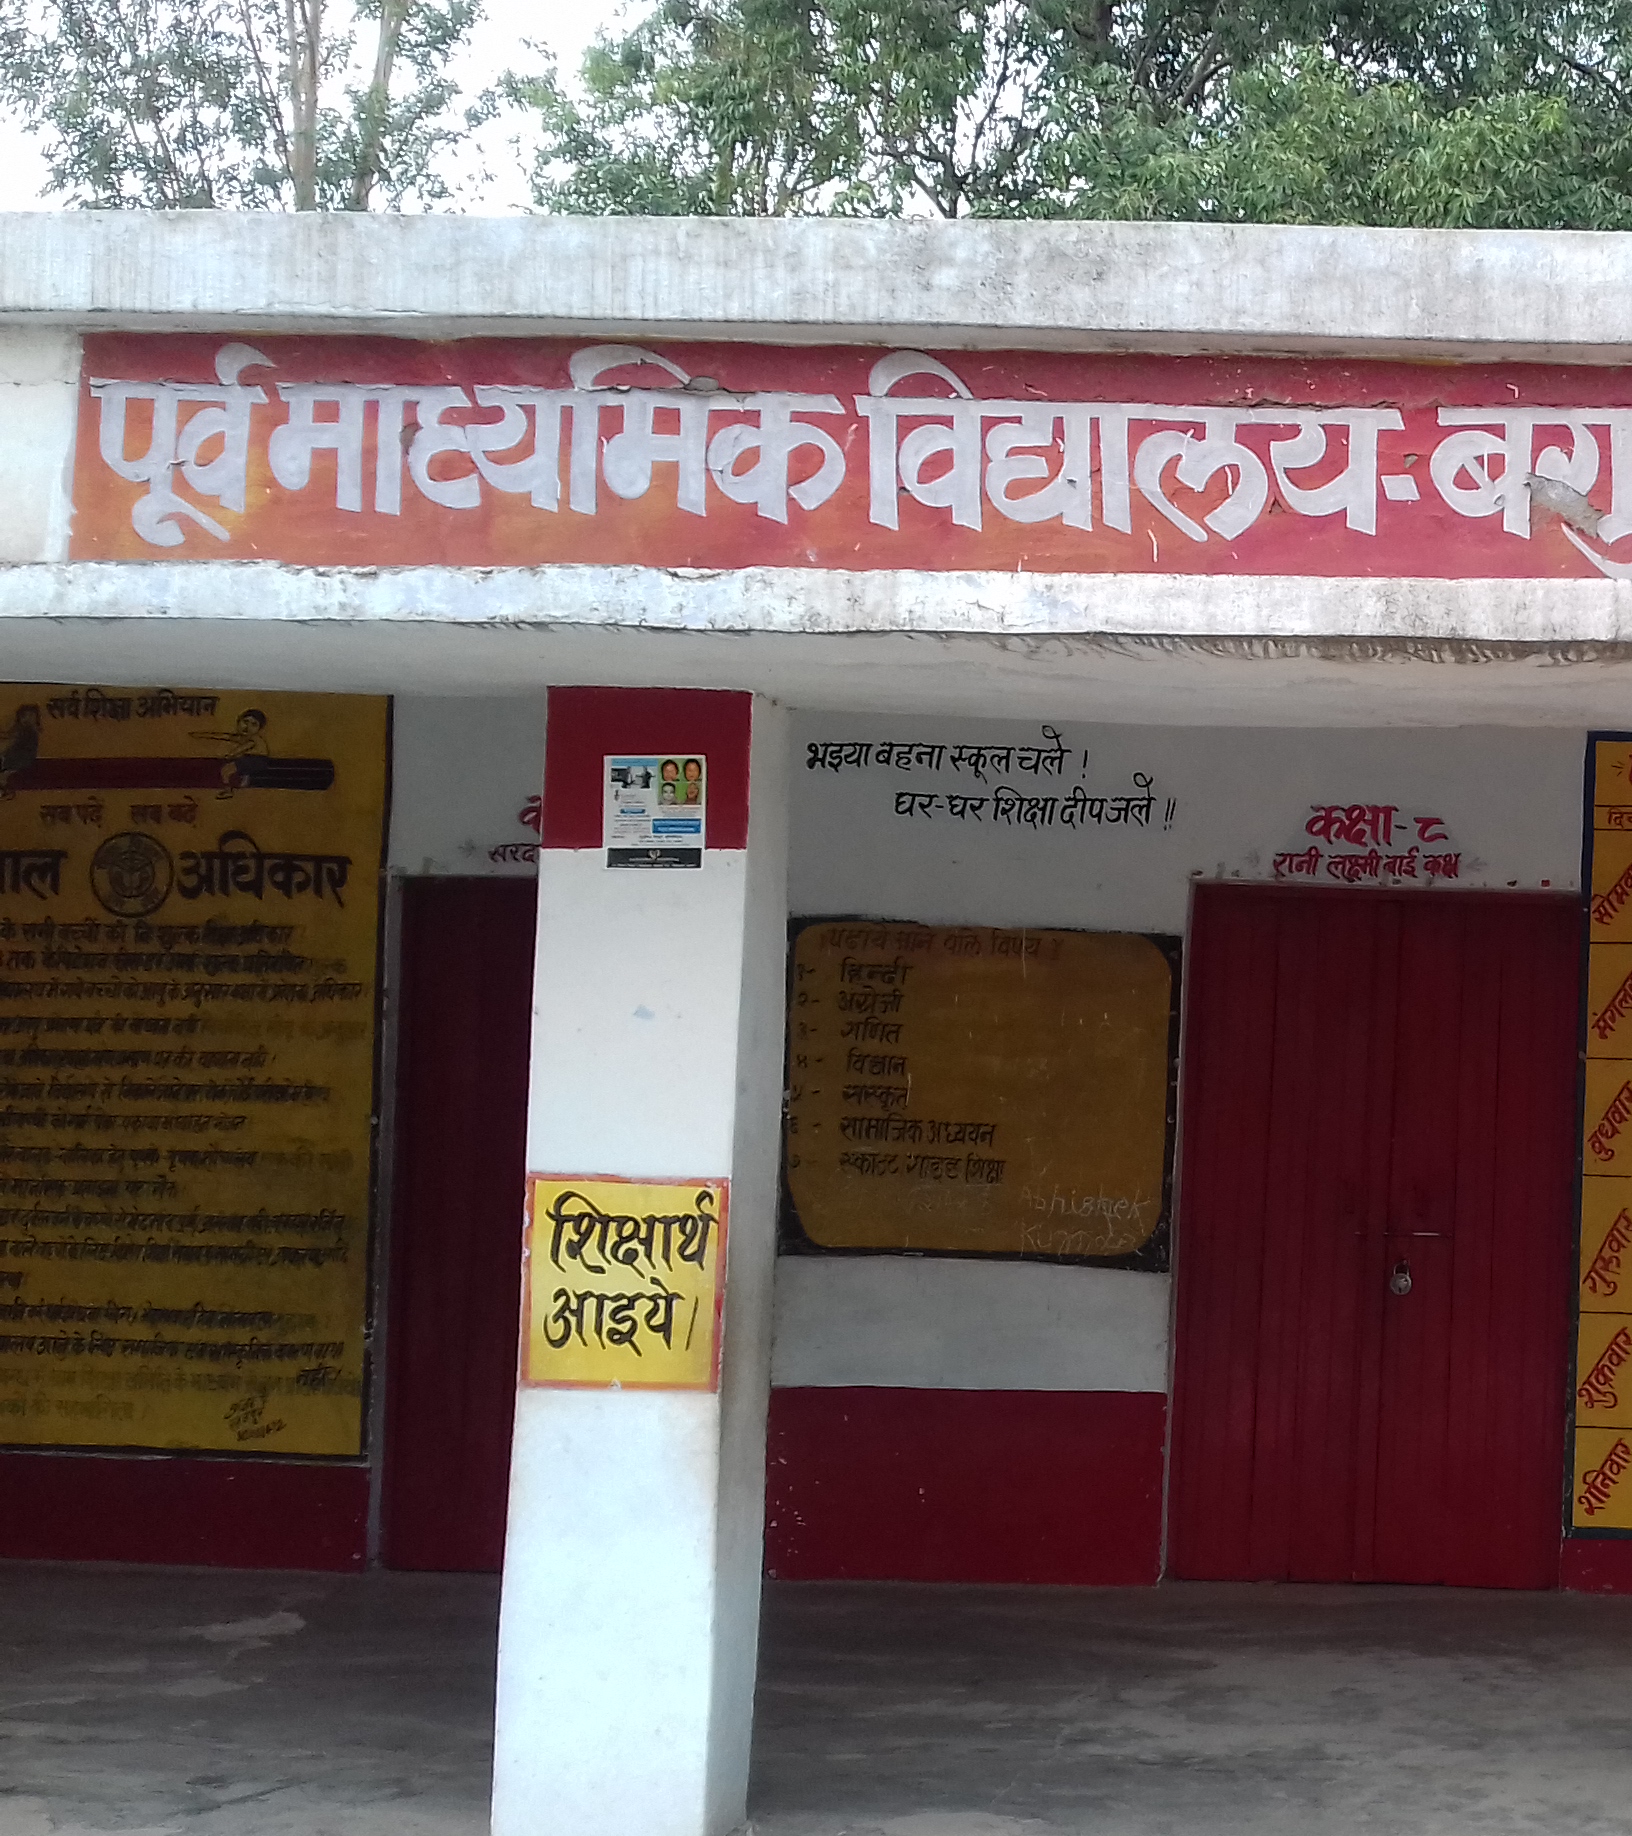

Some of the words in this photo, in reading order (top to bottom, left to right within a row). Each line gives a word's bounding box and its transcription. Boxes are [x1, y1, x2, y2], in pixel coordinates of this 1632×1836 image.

[90, 342, 278, 547] पूर्व
[267, 344, 848, 526] माध्यमिक
[806, 742, 873, 772] भइया
[875, 742, 947, 772] बहना
[950, 744, 1017, 784] स्कूल
[991, 786, 1059, 830] शिक्षा
[1060, 785, 1105, 830] दीप
[177, 829, 353, 909] अधिकार
[840, 956, 914, 985] हिन्दी
[545, 1189, 719, 1280] शिक्षार्थ
